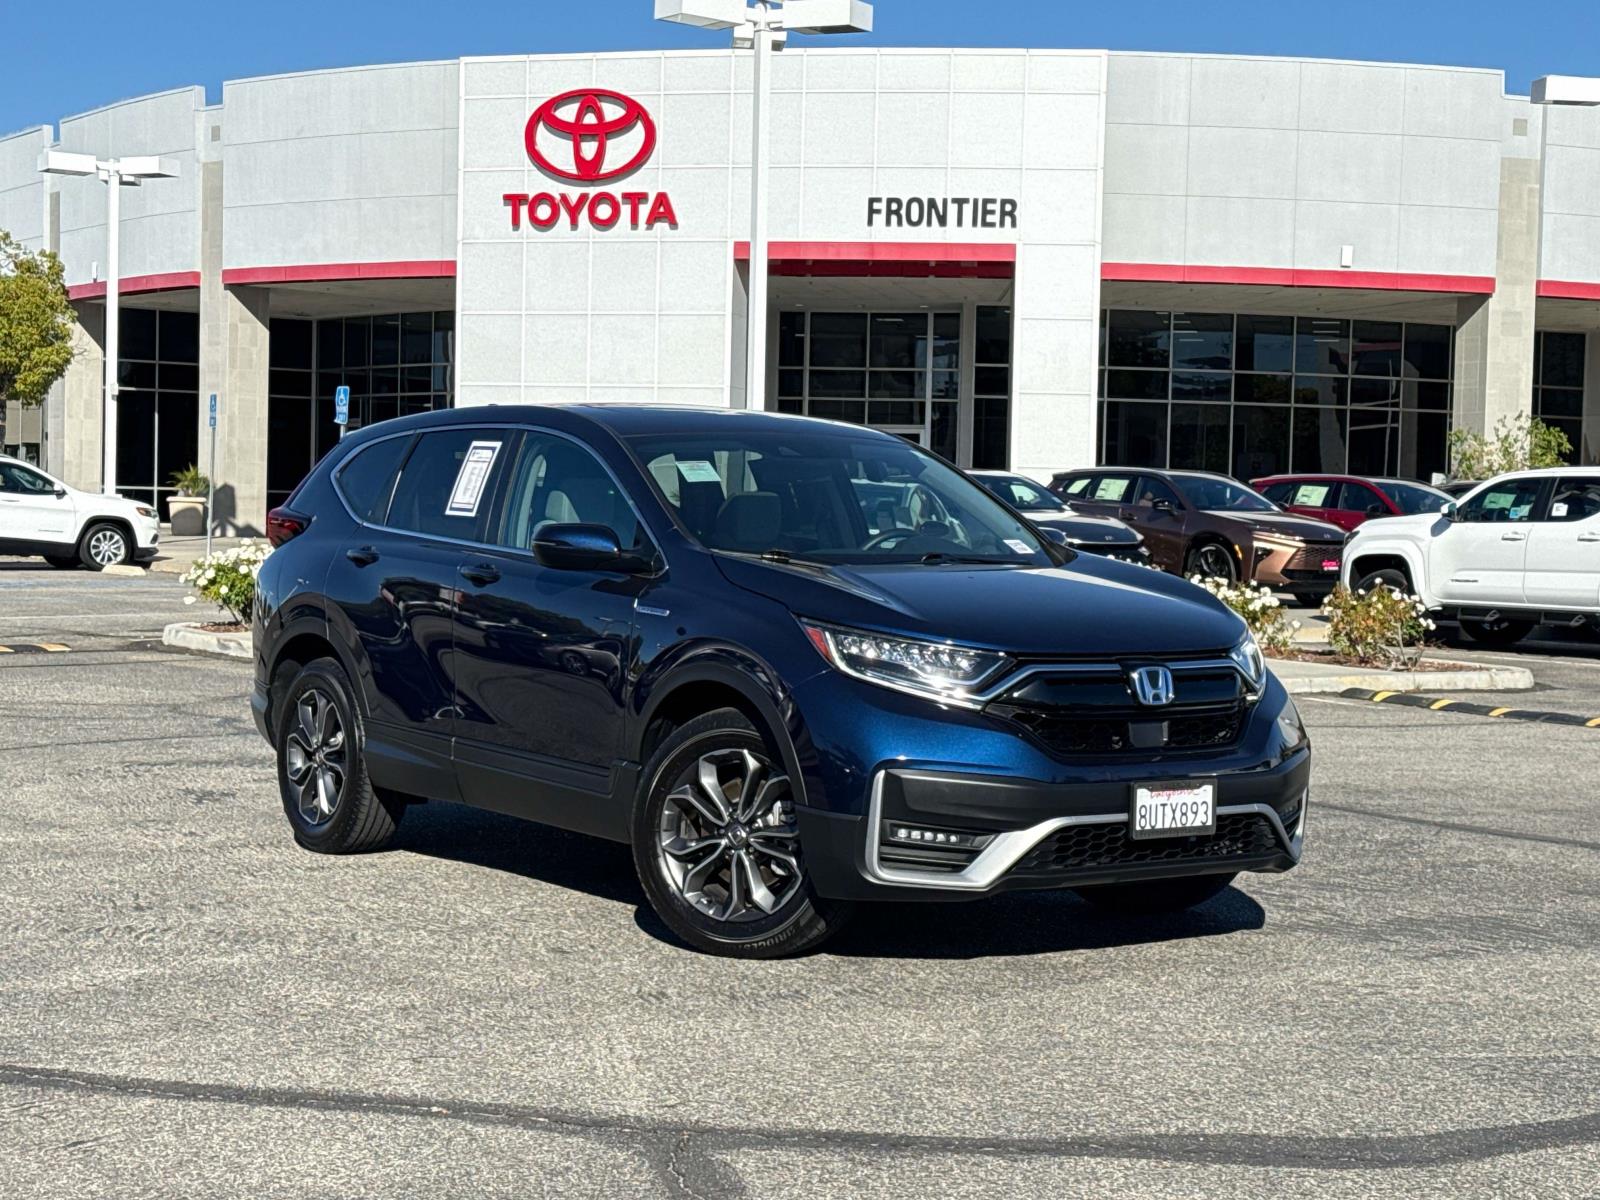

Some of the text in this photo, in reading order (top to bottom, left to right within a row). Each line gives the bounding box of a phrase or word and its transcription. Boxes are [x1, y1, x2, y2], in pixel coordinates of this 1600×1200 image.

[502, 191, 678, 230] TOYOTA
[867, 196, 1018, 229] FRONTIER
[1138, 801, 1209, 830] 8UTX893
